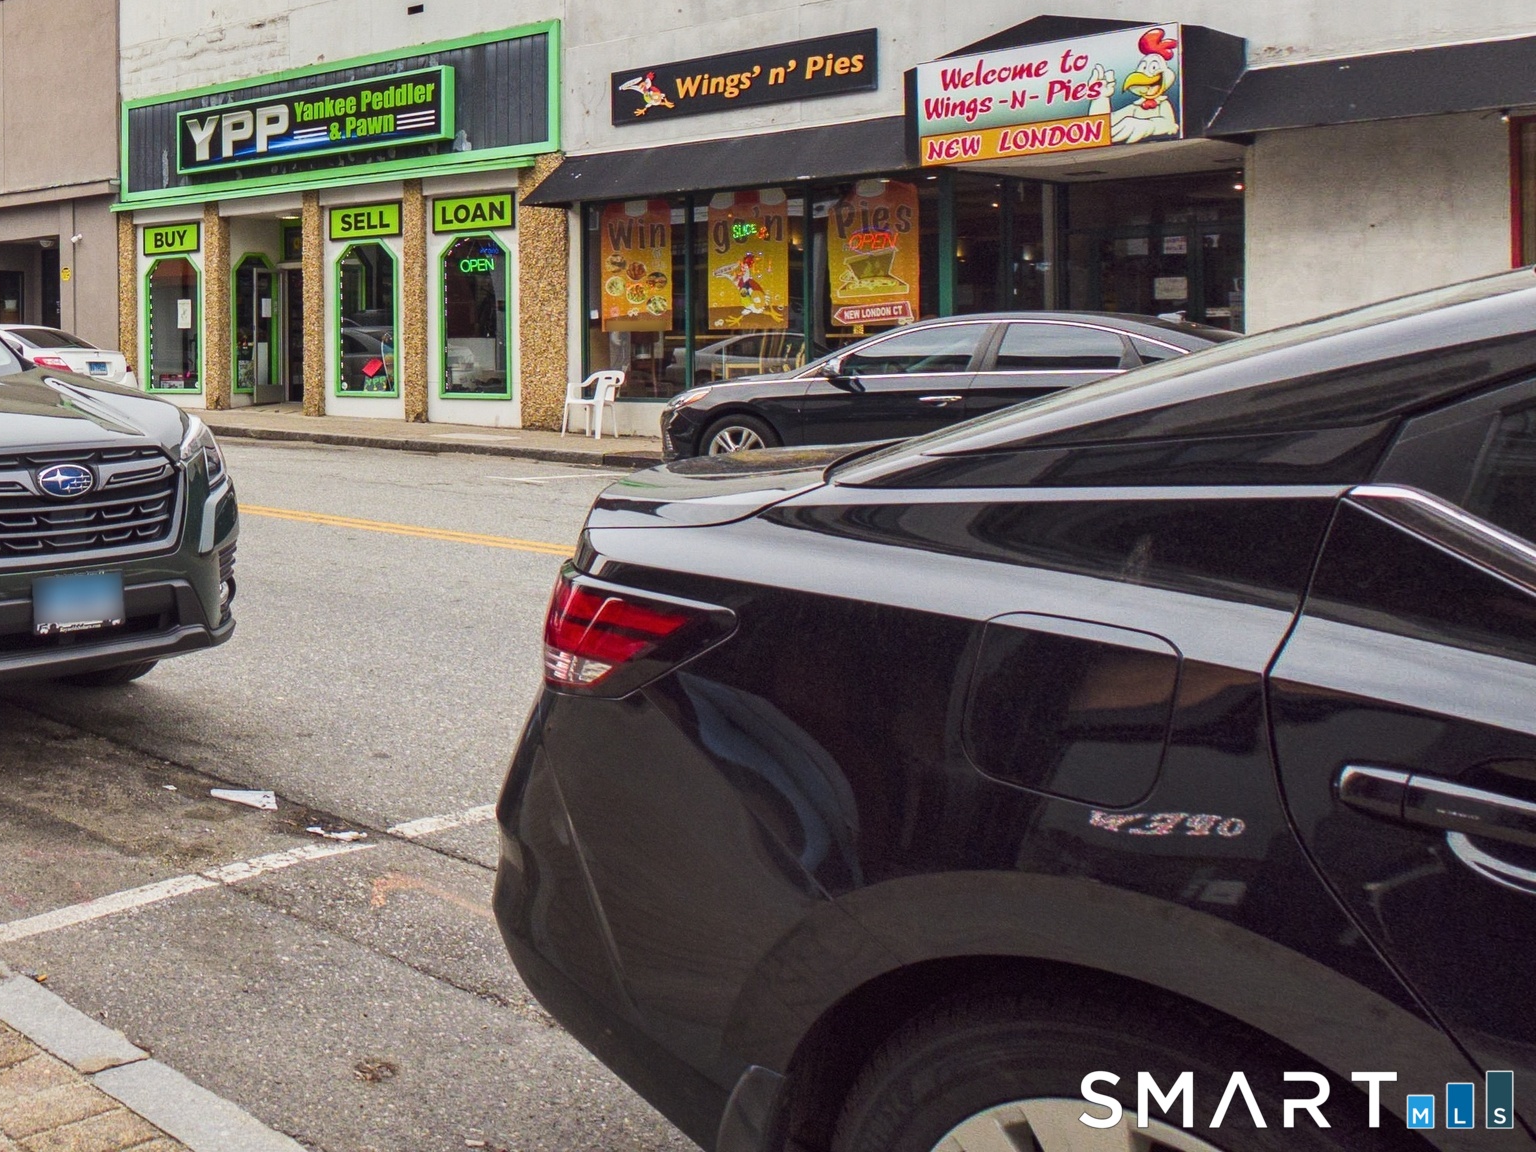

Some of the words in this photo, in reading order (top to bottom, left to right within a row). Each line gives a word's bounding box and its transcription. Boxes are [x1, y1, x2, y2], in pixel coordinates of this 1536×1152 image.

[805, 53, 865, 79] Pies
[940, 59, 1049, 92] Welcome
[1060, 48, 1089, 75] to
[293, 94, 357, 124] Yankee
[360, 82, 436, 108] Peddler
[924, 96, 993, 122] Wings
[1046, 79, 1102, 105] Pies
[185, 103, 290, 162] YPP
[328, 121, 343, 142] &
[345, 113, 395, 140] Pawn
[927, 136, 981, 161] NEW
[998, 120, 1103, 153] LONDON
[340, 210, 391, 233] SELL
[441, 200, 505, 226] LOAN
[154, 229, 188, 249] BUY
[608, 218, 667, 251] Win
[732, 223, 758, 239] SLICE
[848, 232, 898, 251] OPEN
[460, 258, 495, 273] OPEN
[844, 309, 860, 321] NEW
[861, 307, 891, 319] LONDON
[892, 305, 903, 316] CT
